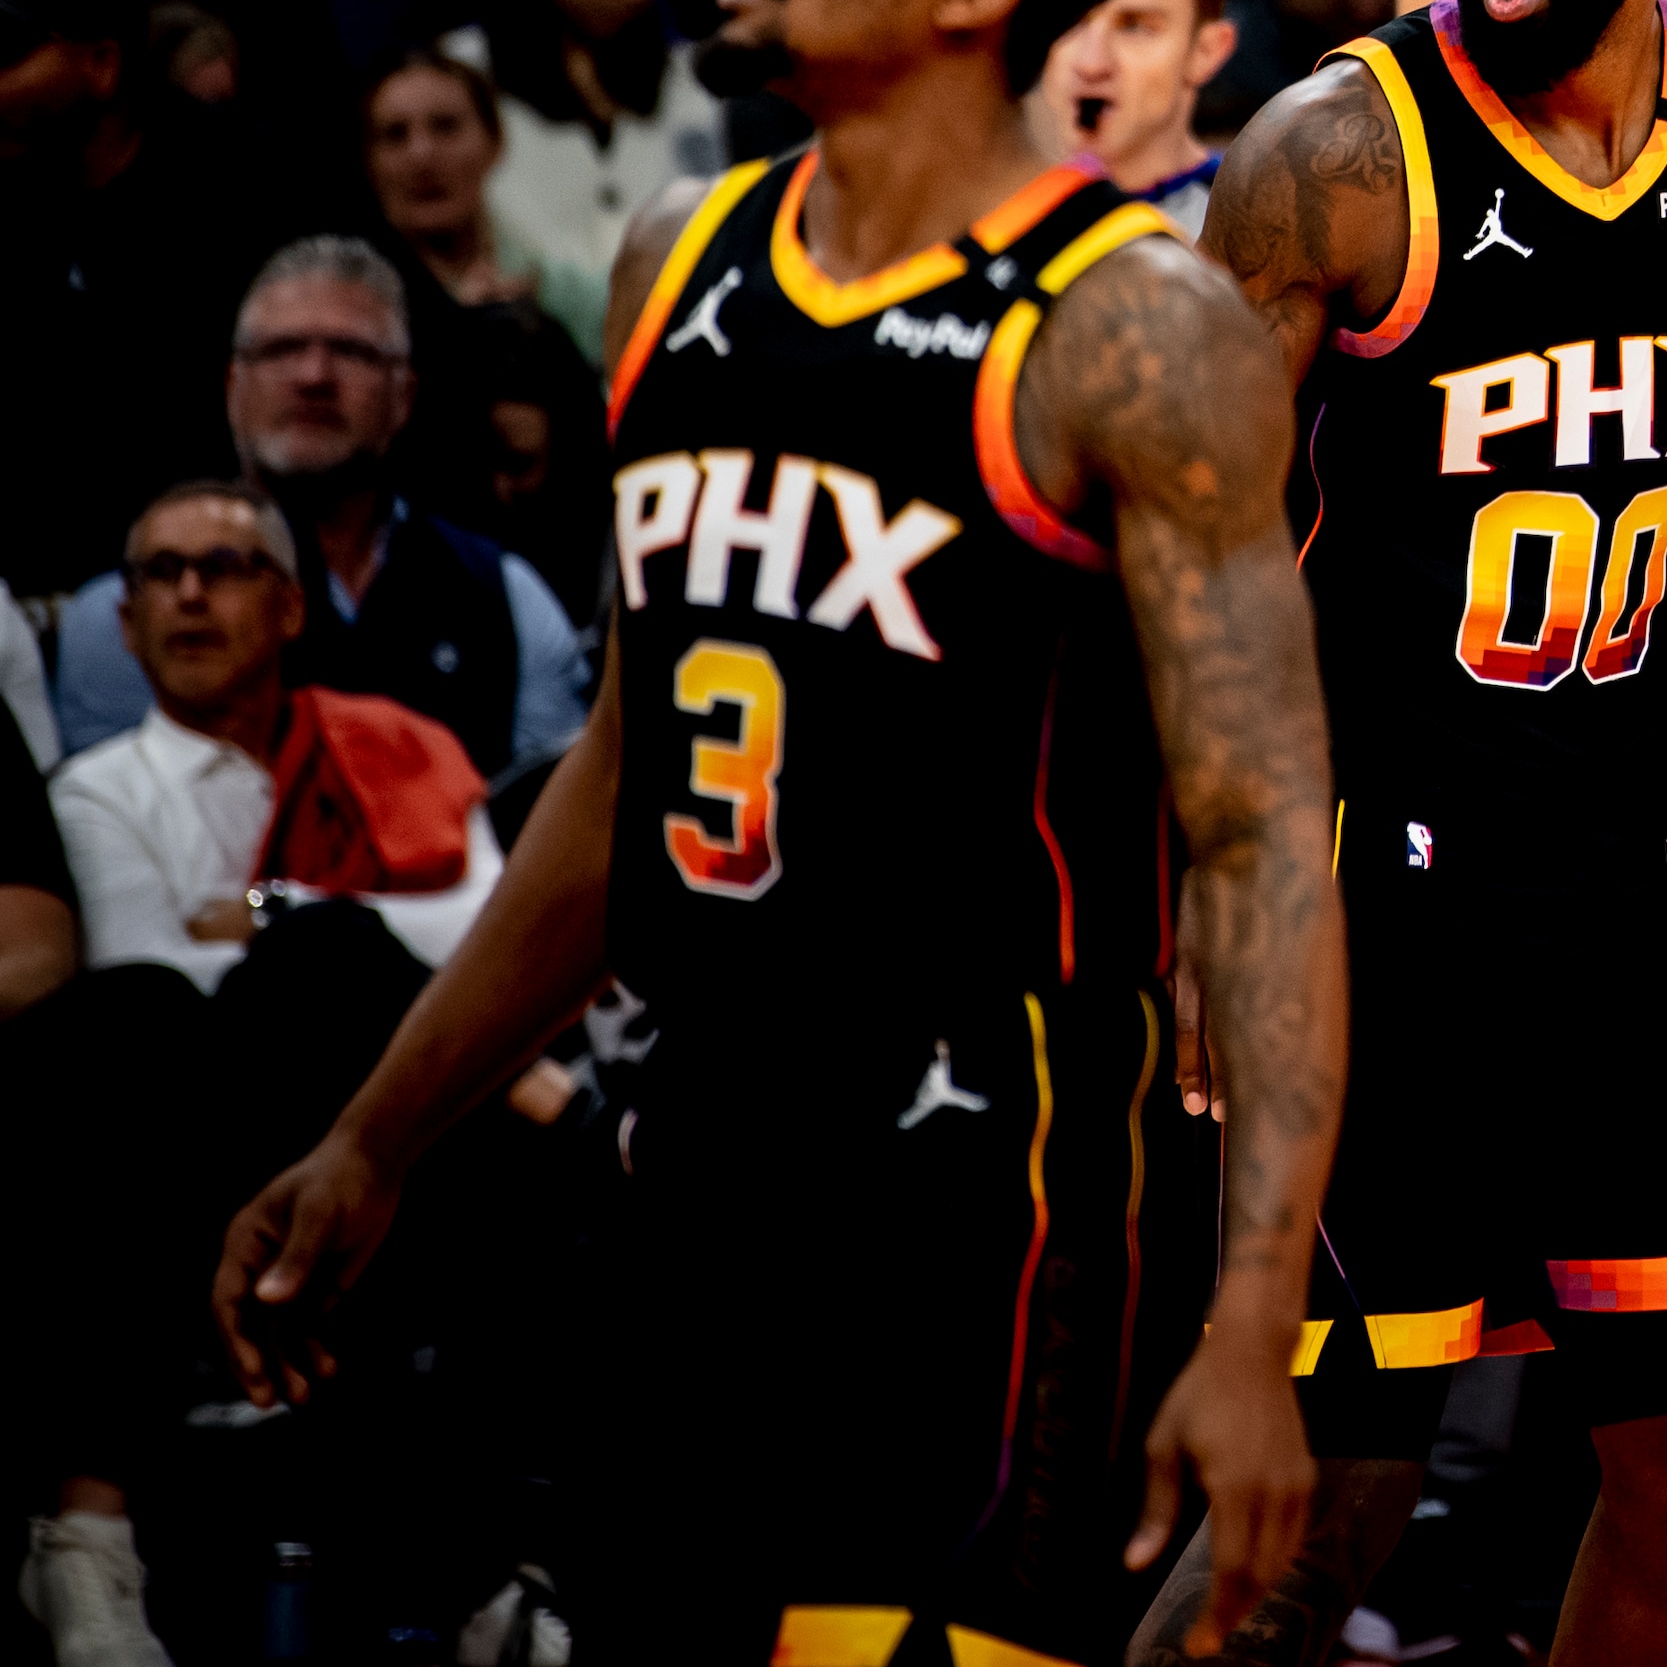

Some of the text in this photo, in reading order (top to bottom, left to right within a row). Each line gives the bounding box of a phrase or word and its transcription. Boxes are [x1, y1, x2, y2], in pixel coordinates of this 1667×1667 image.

[873, 306, 993, 361] PayPal
[613, 447, 964, 663] PHX
[664, 638, 787, 902] 3
